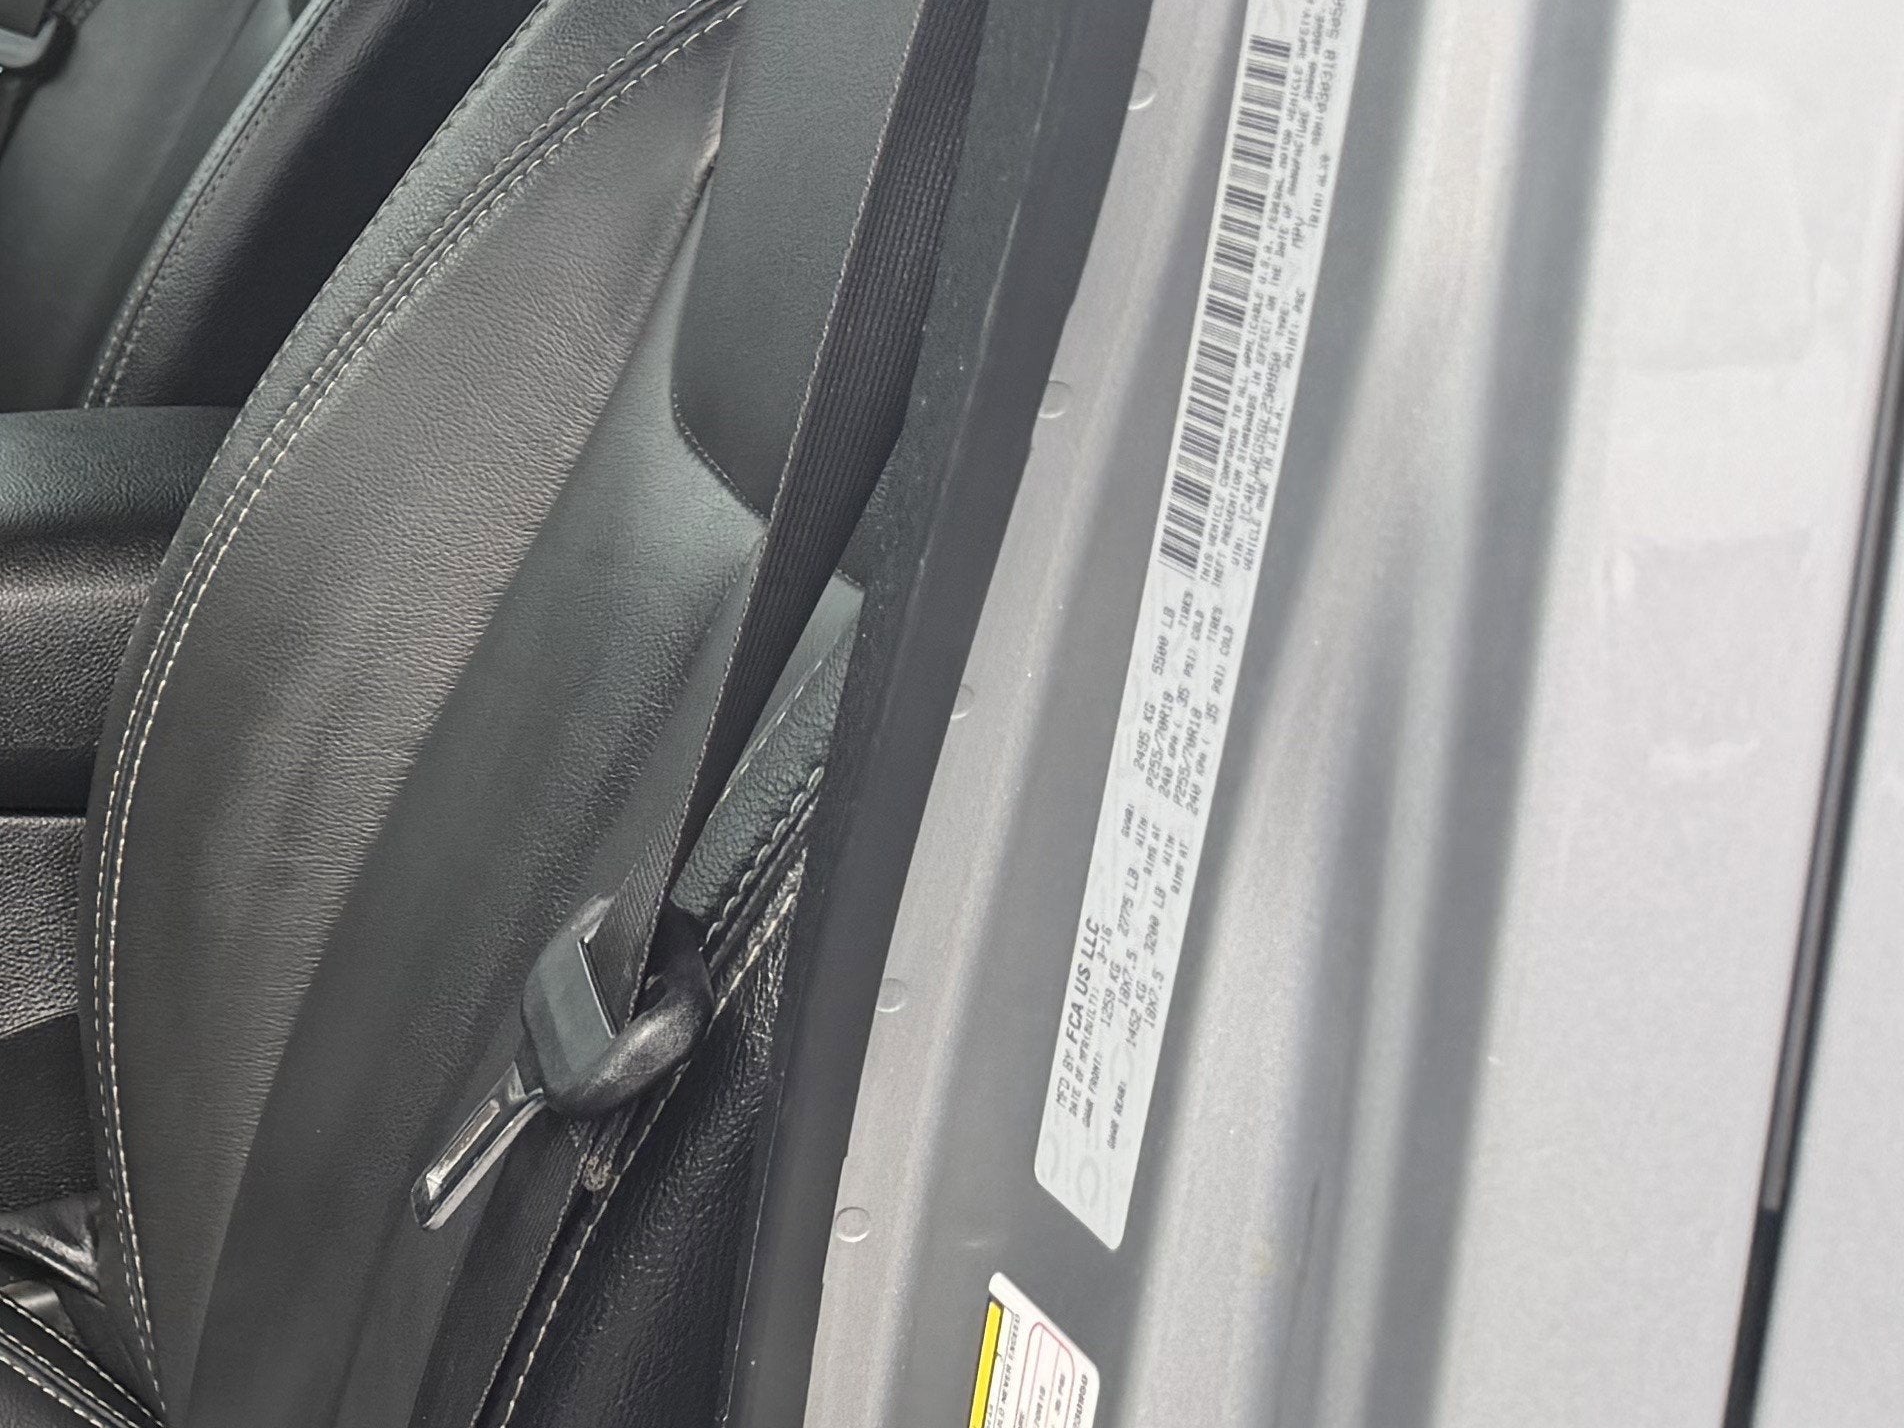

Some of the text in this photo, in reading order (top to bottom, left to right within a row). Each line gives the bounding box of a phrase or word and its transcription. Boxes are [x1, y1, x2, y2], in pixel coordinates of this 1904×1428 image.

[1289, 215, 1308, 250] MPV
[1132, 603, 1175, 773] 2495 KG 5500 LB
[1175, 682, 1190, 709] 35
[1203, 698, 1219, 726] 35
[1144, 687, 1174, 792] P255/70R18
[1171, 703, 1203, 809] P255/70R18
[1124, 863, 1139, 892] LB
[1151, 883, 1166, 911] LB
[1080, 913, 1100, 963] LLC
[1115, 892, 1134, 939] 2775
[1142, 911, 1161, 958] 3200
[1095, 921, 1113, 967] 3-16
[1073, 959, 1091, 999] US
[1107, 957, 1121, 985] KG
[1133, 976, 1148, 1006] KG
[1065, 995, 1085, 1047] FCA
[1099, 984, 1116, 1030] 1259
[1124, 1005, 1142, 1051] 1452
[1062, 1047, 1075, 1074] BY
